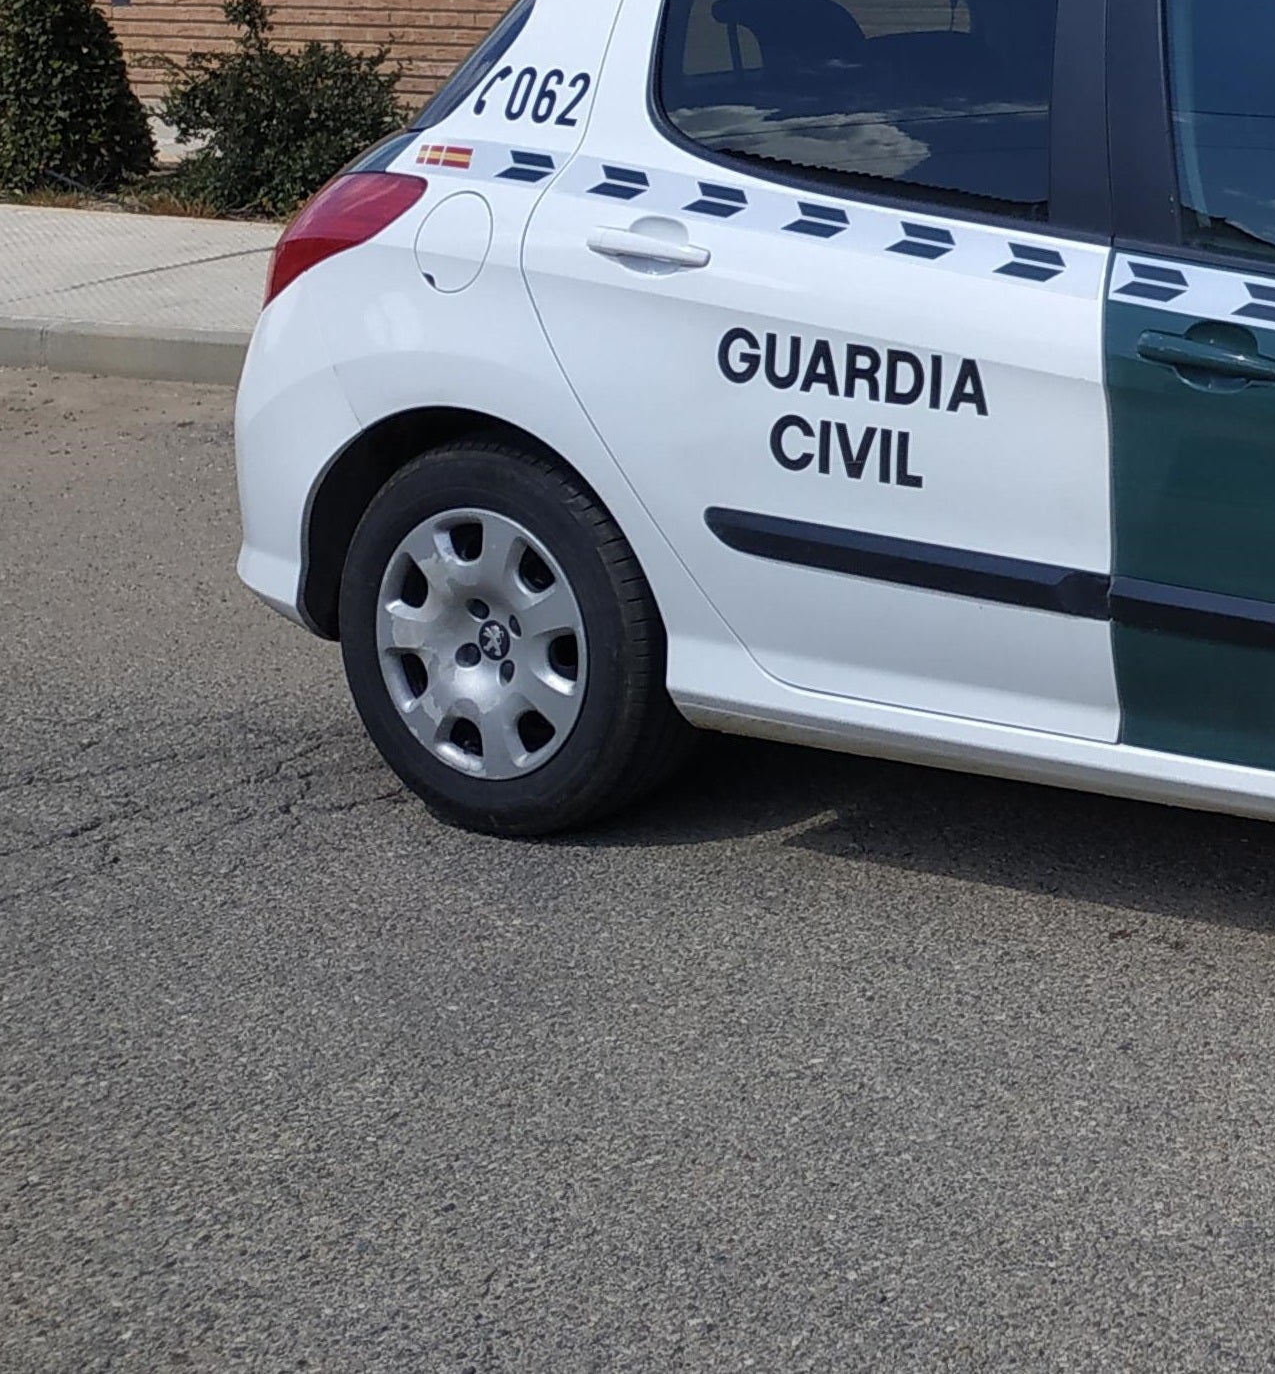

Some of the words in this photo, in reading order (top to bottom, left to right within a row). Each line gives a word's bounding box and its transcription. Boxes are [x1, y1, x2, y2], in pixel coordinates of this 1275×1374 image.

[504, 66, 591, 127] 062
[717, 326, 989, 417] GUARDIA
[769, 414, 924, 489] CIVIL
